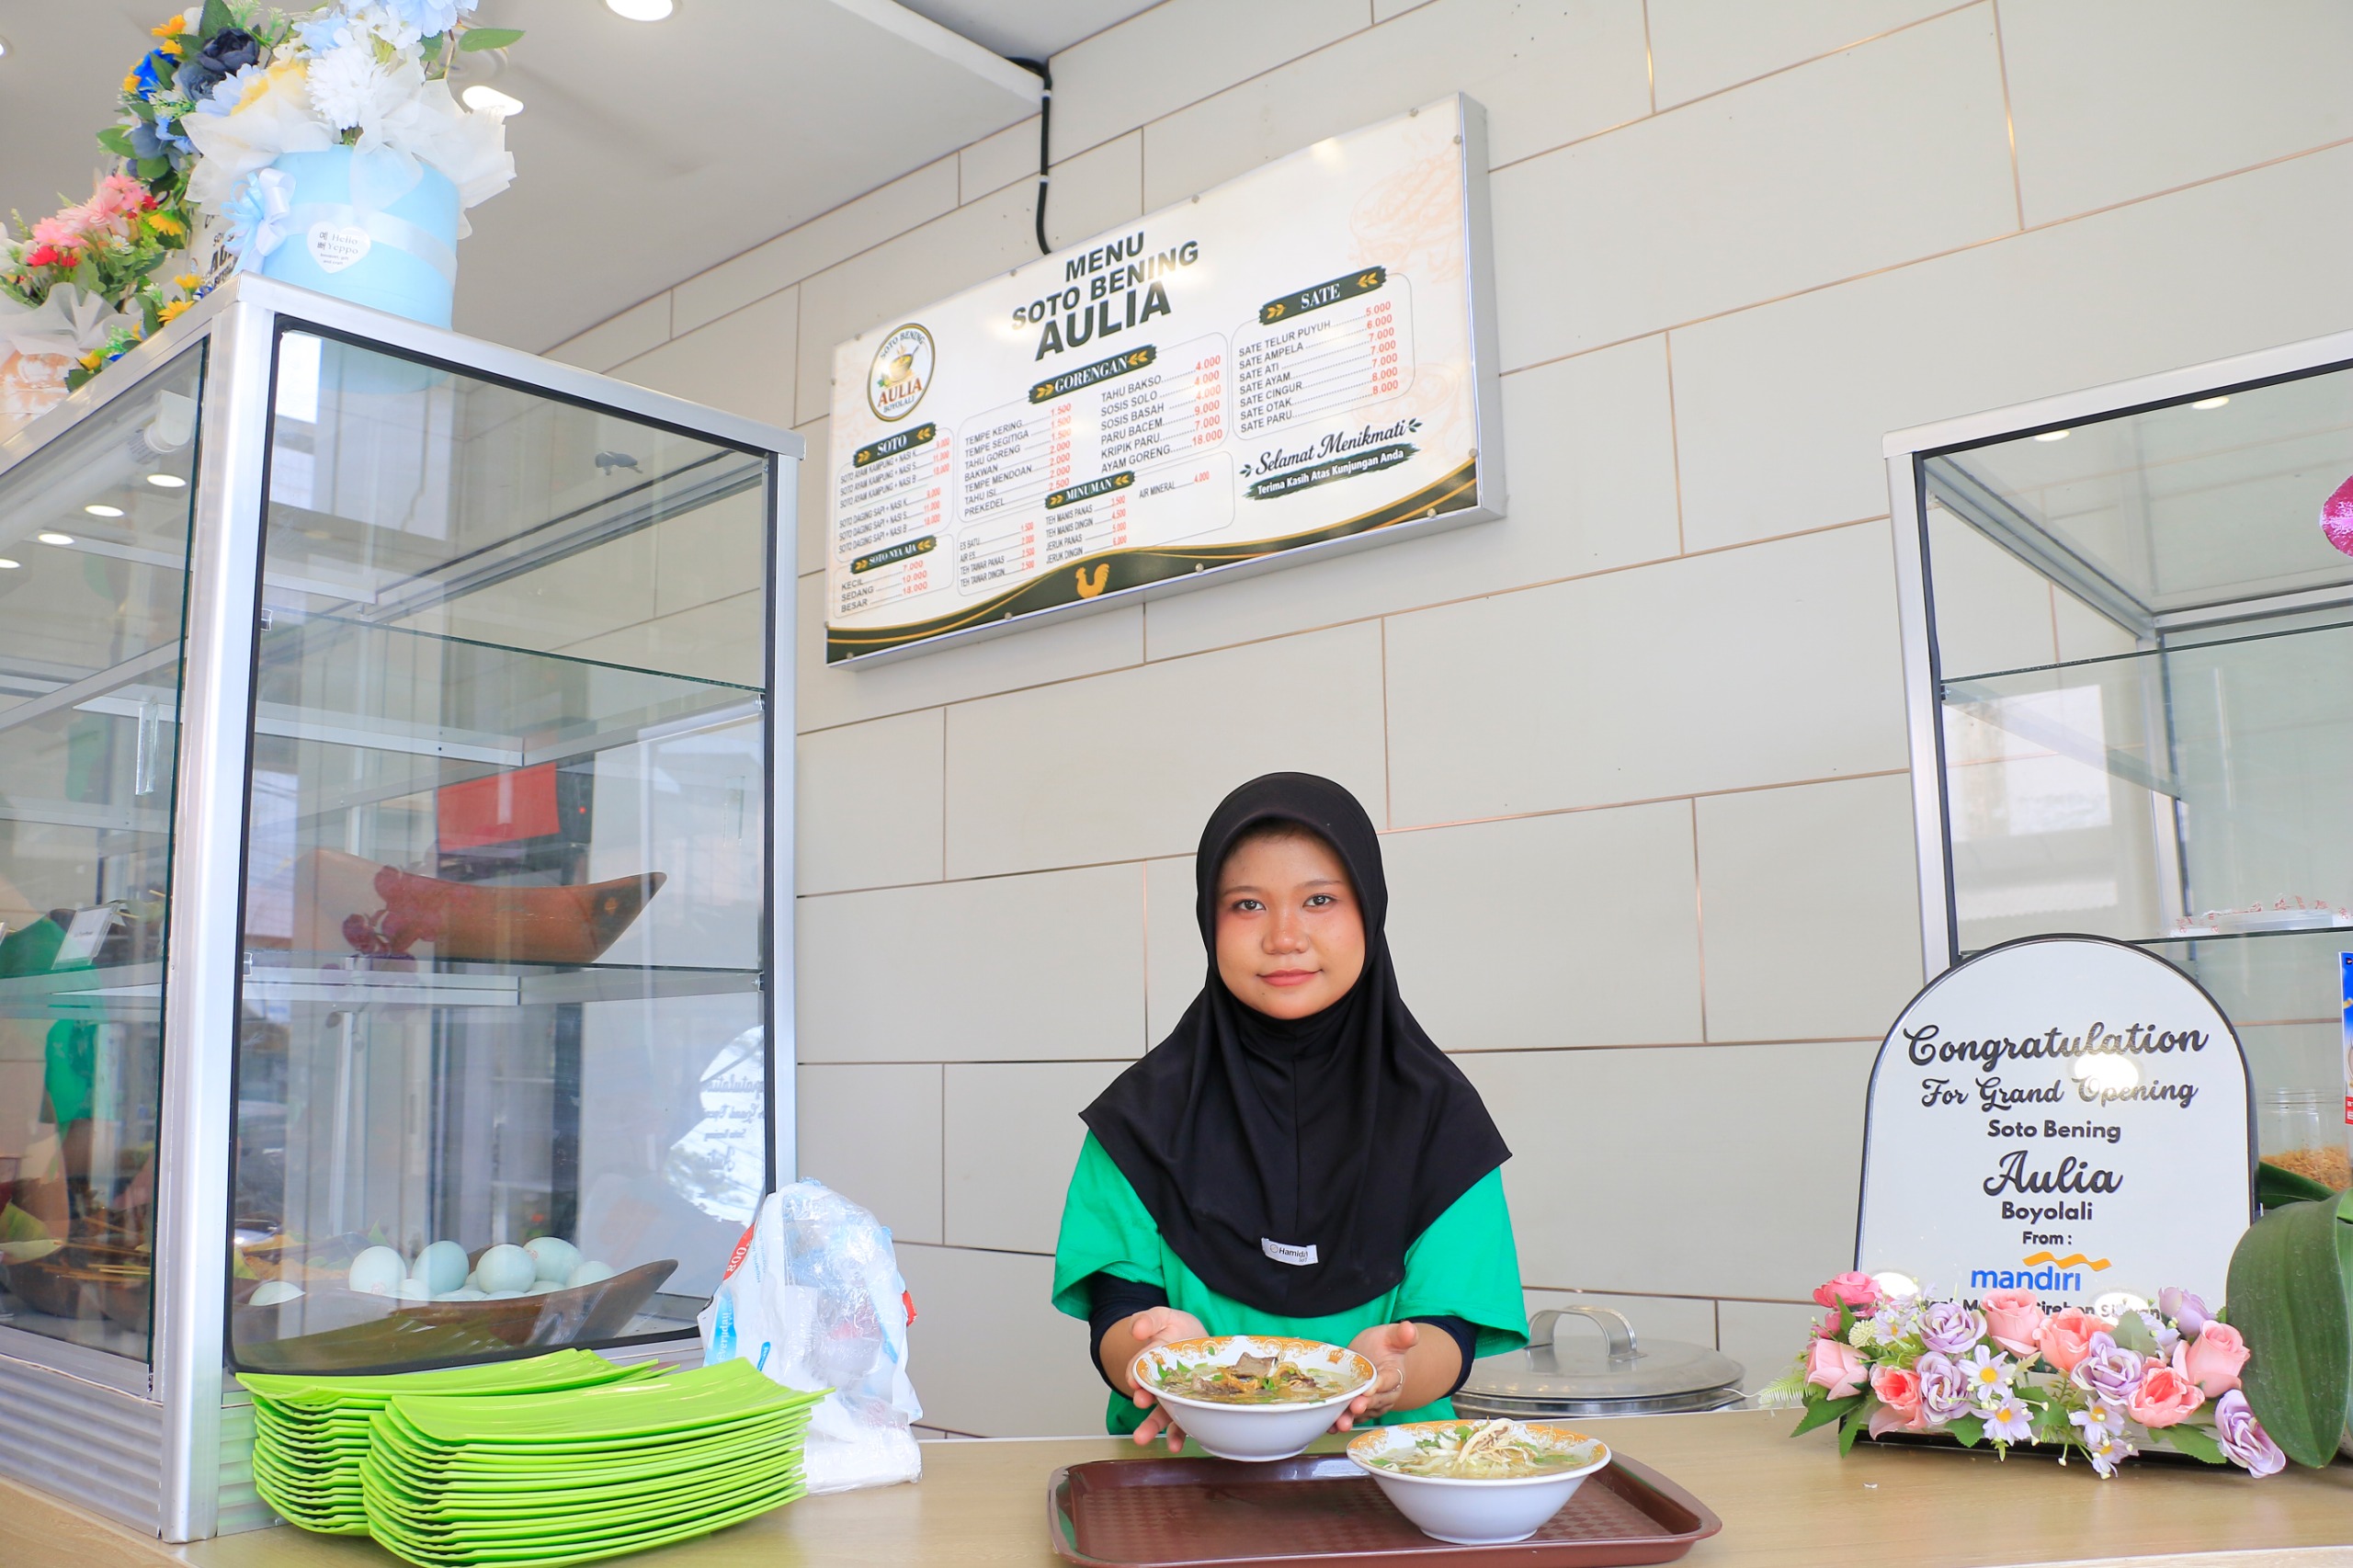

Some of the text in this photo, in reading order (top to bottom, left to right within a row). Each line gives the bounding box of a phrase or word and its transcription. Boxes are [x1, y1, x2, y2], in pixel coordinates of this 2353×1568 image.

[332, 233, 358, 244] Hello
[1066, 232, 1144, 282] MENU
[1012, 240, 1199, 330] SOTO BENING
[1301, 283, 1340, 309] SATE
[1035, 280, 1171, 361] AULIA
[1239, 301, 1392, 358] SATE TELUR PUYUH 5.000
[881, 331, 925, 358] SOTO BENING
[1239, 314, 1392, 369] SATE AMPELA 6.000
[1239, 327, 1394, 382] SATE ATI 7.000
[1055, 356, 1128, 392] GORENGAN
[1101, 355, 1221, 403] TAHU BAKSO 4.000
[1240, 340, 1396, 395] SATE AYAM 7.000
[1240, 353, 1397, 407] SATE CINGUR 7.000
[878, 378, 922, 407] AULIA
[883, 395, 915, 413] BOYOLALI
[1101, 370, 1220, 416] SOSIS SOLO 4.000
[1101, 384, 1221, 431] SOSIS BASAH 4.000
[1241, 367, 1398, 420] SATE OTAK 8.000
[1241, 380, 1399, 433] SATE PARU 8.000
[965, 403, 1071, 446] TEMPE KERING 1.500
[965, 415, 1071, 458] TEMPE SEGITIGA 1.500
[1101, 400, 1220, 445] PARU BACEM 9.000
[1101, 415, 1220, 459] KRIPIK PARU 7.000
[877, 435, 907, 456] SOTO
[964, 440, 1070, 482] BAKWAN 2.000
[965, 444, 1021, 470] TAHU GORENG
[1101, 429, 1222, 473] AYAM GORENG 18.000
[1256, 419, 1407, 474] Selamat Menikmati
[840, 472, 853, 483] SOTO
[869, 459, 893, 473] KAMPUNG
[899, 452, 911, 461] NASI
[840, 484, 853, 495] SOTO
[869, 471, 893, 486] KAMPUNG
[899, 465, 911, 474] NASI
[965, 452, 1070, 493] TEMPE MENDOAN 2.000
[1257, 449, 1404, 494] Terima Kasih Atas Kunjungan Anda
[839, 497, 853, 508] SOTO
[869, 483, 893, 499] KAMPUNG
[899, 477, 911, 487] NASI
[965, 465, 1070, 505] TAHU ISI 2.000
[965, 477, 1070, 517] PREKEDEL 2.500
[1065, 477, 1112, 501] MINUMAN
[1139, 471, 1210, 499] AIR MINERAL 4.000
[838, 514, 902, 540] SOTO DAGING SAPI NASI
[839, 501, 902, 528] SOTO DAGING SAPI NASI
[1046, 505, 1093, 526] TEH MANIS PANAS
[1046, 528, 1055, 538] TEH
[1057, 524, 1074, 535] MANIS
[1075, 517, 1093, 529] DINGIN
[838, 527, 902, 553] SOTO DAGING SAPI NASI
[869, 544, 916, 565] SOTO NYA AJA
[960, 538, 980, 551] ES BATU
[1046, 534, 1082, 551] JERUK PANAS
[1046, 547, 1083, 564] JERUK DINGIN
[960, 551, 975, 563] AIR ES
[961, 556, 1005, 575] TEH TAWAR PANAS
[841, 571, 926, 602] SEDANG 10.000
[842, 560, 924, 591] KECIL 7.000
[961, 568, 1005, 587] TEH TAWAR DINGIN
[841, 598, 868, 612] BESAR
[1903, 1021, 2209, 1072] Congratulation
[1921, 1075, 2199, 1112] For Grand Opening
[1987, 1119, 2121, 1143] Soto Bening
[1983, 1150, 2123, 1196] Aulia
[2002, 1201, 2093, 1224] Boyolali
[2022, 1232, 2063, 1244] From
[727, 1246, 746, 1272] 800
[1971, 1267, 2081, 1291] mandiri
